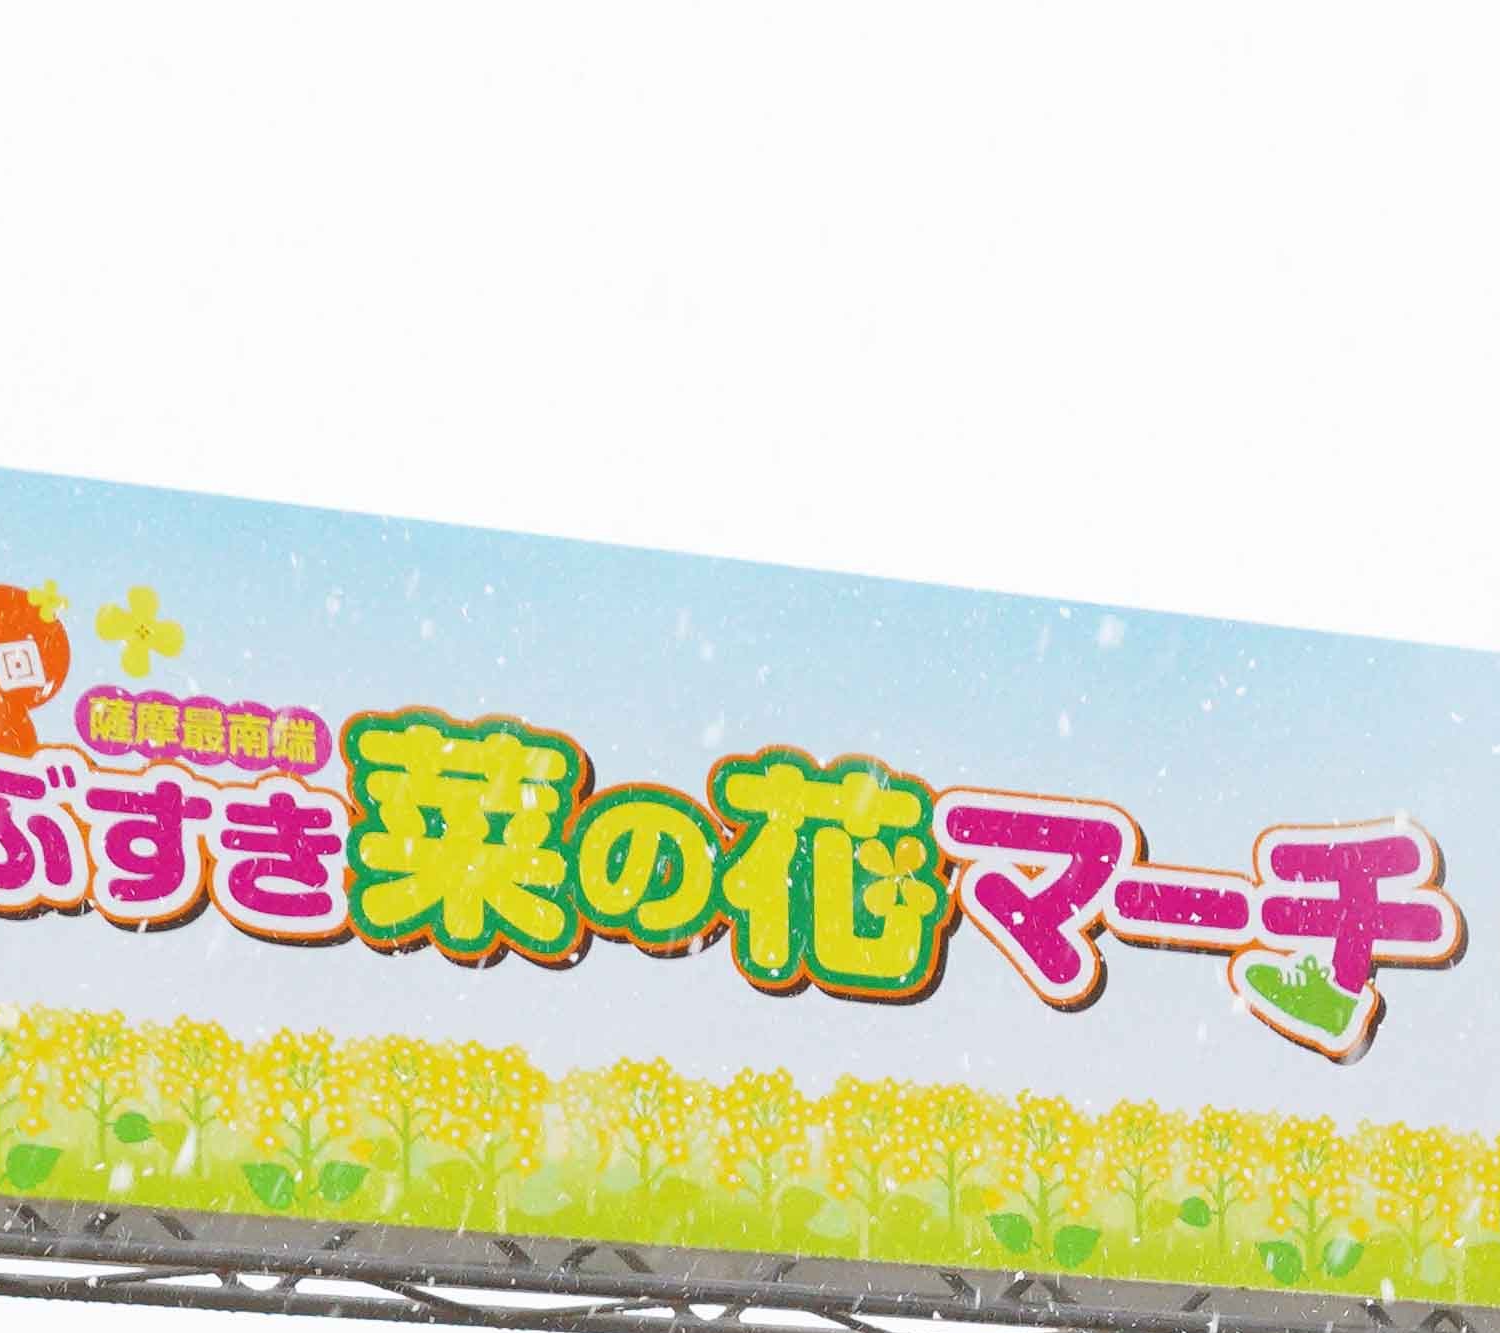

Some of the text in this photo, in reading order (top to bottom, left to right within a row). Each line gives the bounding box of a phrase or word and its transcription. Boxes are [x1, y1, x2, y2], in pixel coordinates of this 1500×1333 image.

[87, 695, 318, 765] 薩摩最南端
